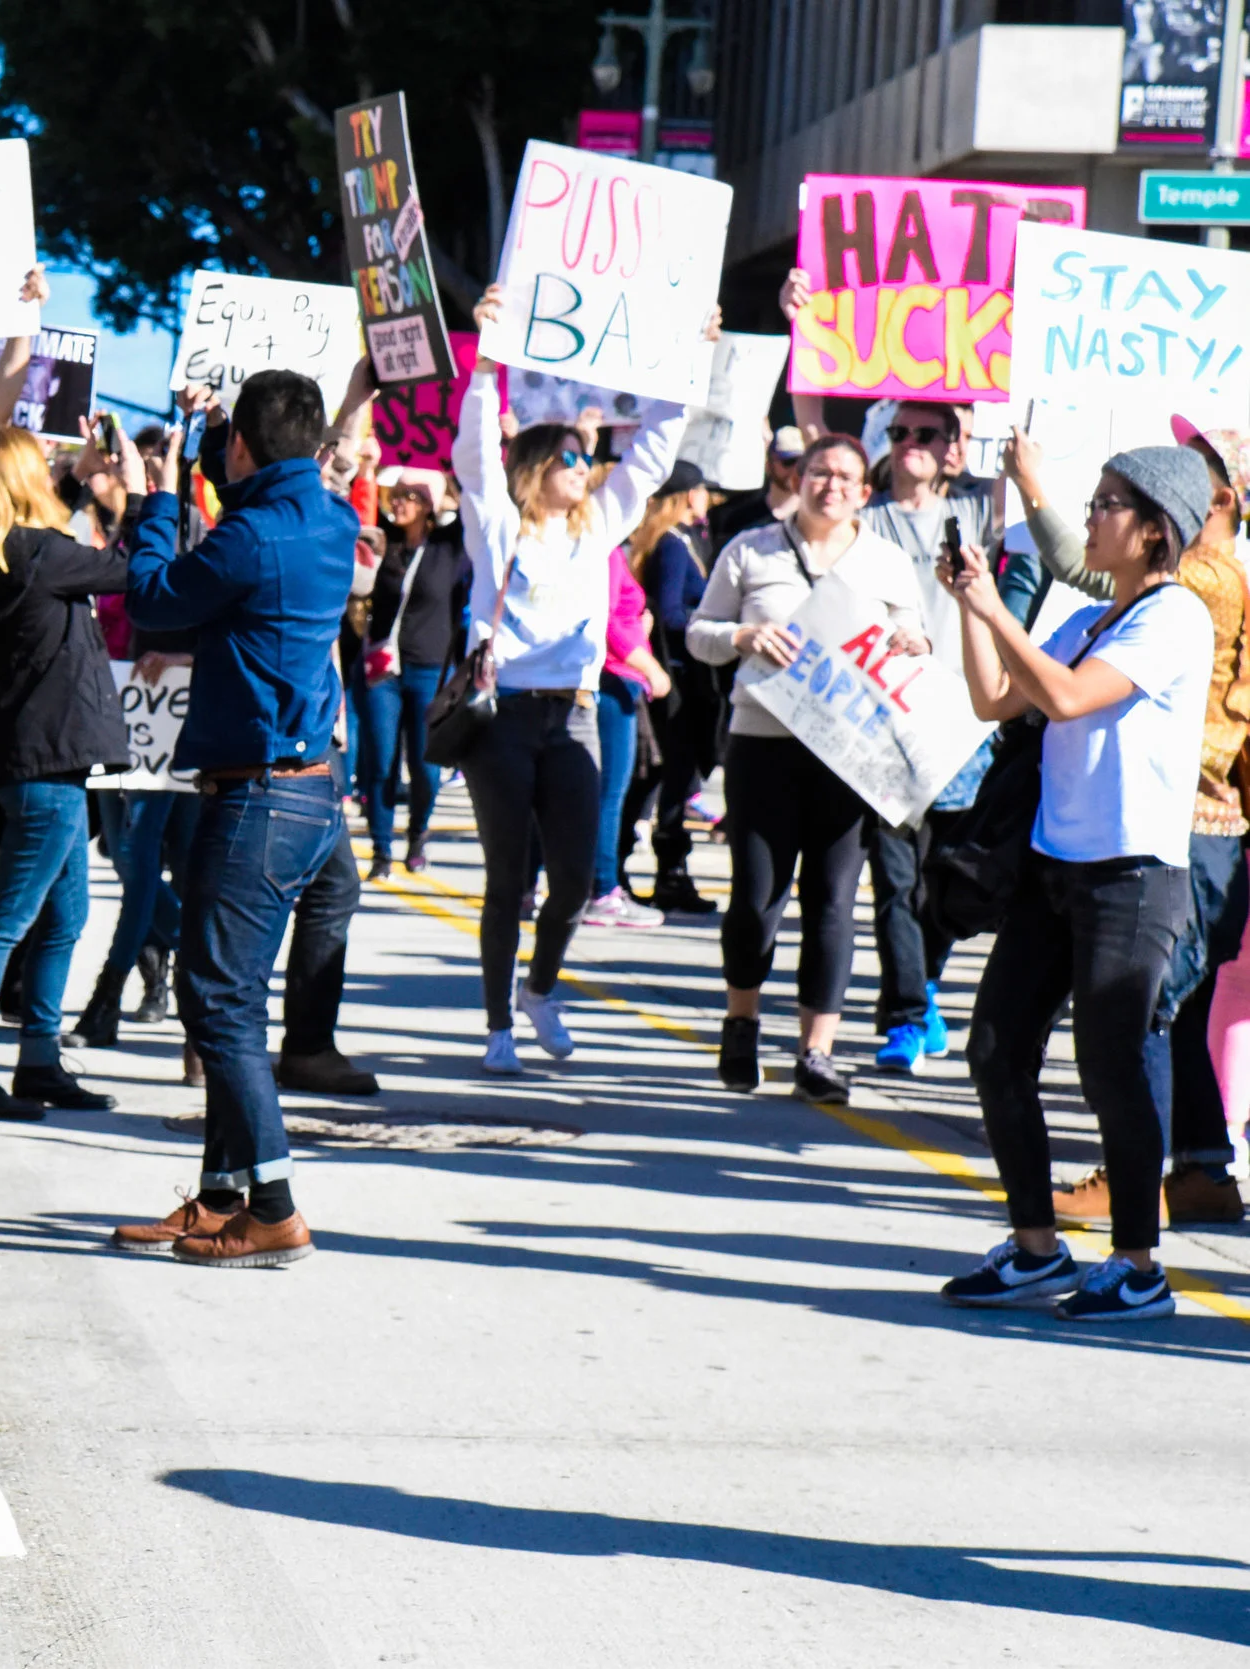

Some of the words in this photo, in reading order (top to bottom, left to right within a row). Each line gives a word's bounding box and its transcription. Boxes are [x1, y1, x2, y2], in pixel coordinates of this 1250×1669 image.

[350, 106, 382, 158] TRY
[1158, 184, 1240, 211] Temple
[1041, 250, 1228, 321] STAY
[252, 335, 281, 360] 4
[1045, 314, 1243, 394] NASTY!
[840, 623, 924, 713] ALL
